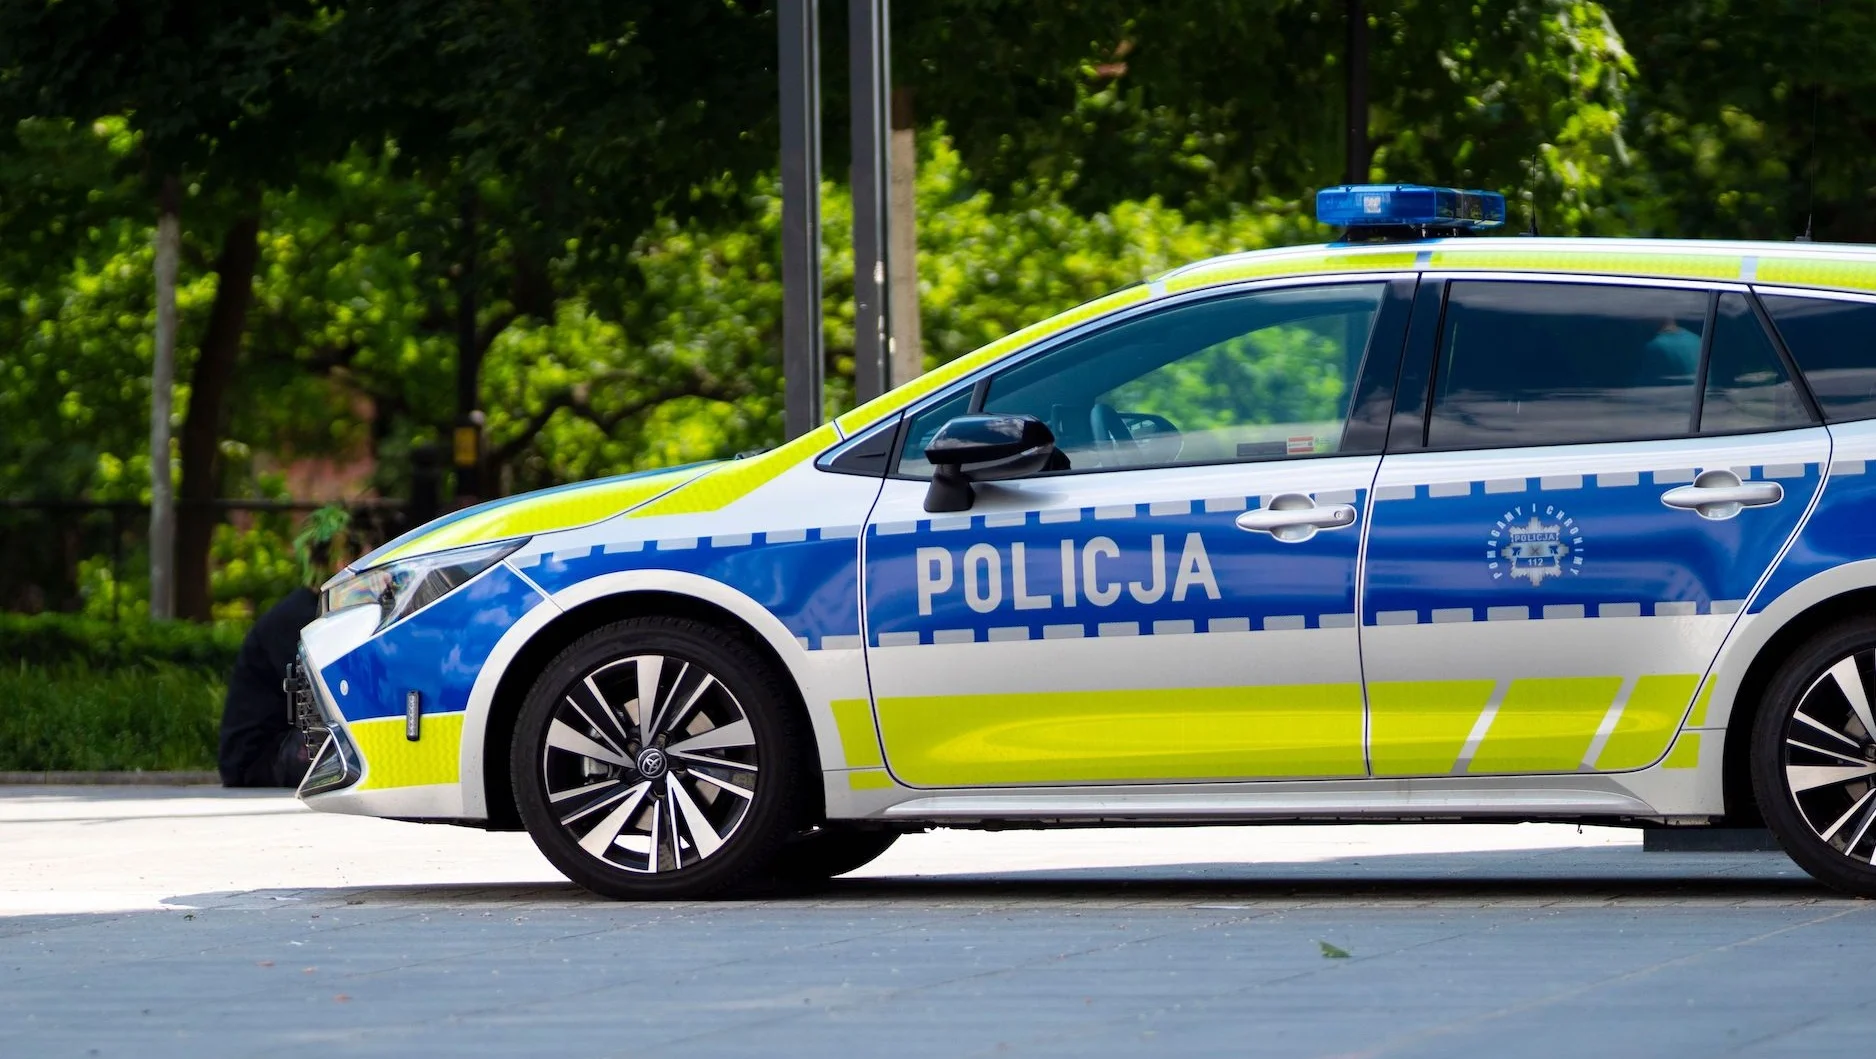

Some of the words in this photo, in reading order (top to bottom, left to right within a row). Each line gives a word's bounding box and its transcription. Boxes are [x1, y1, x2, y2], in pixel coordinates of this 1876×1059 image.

[1487, 506, 1522, 579] POMAGAMY
[1532, 503, 1536, 513] I
[1546, 505, 1584, 575] CHRONIMY
[1514, 533, 1556, 542] POLICJA
[916, 532, 1222, 616] POLICJA
[1528, 558, 1544, 566] 112
